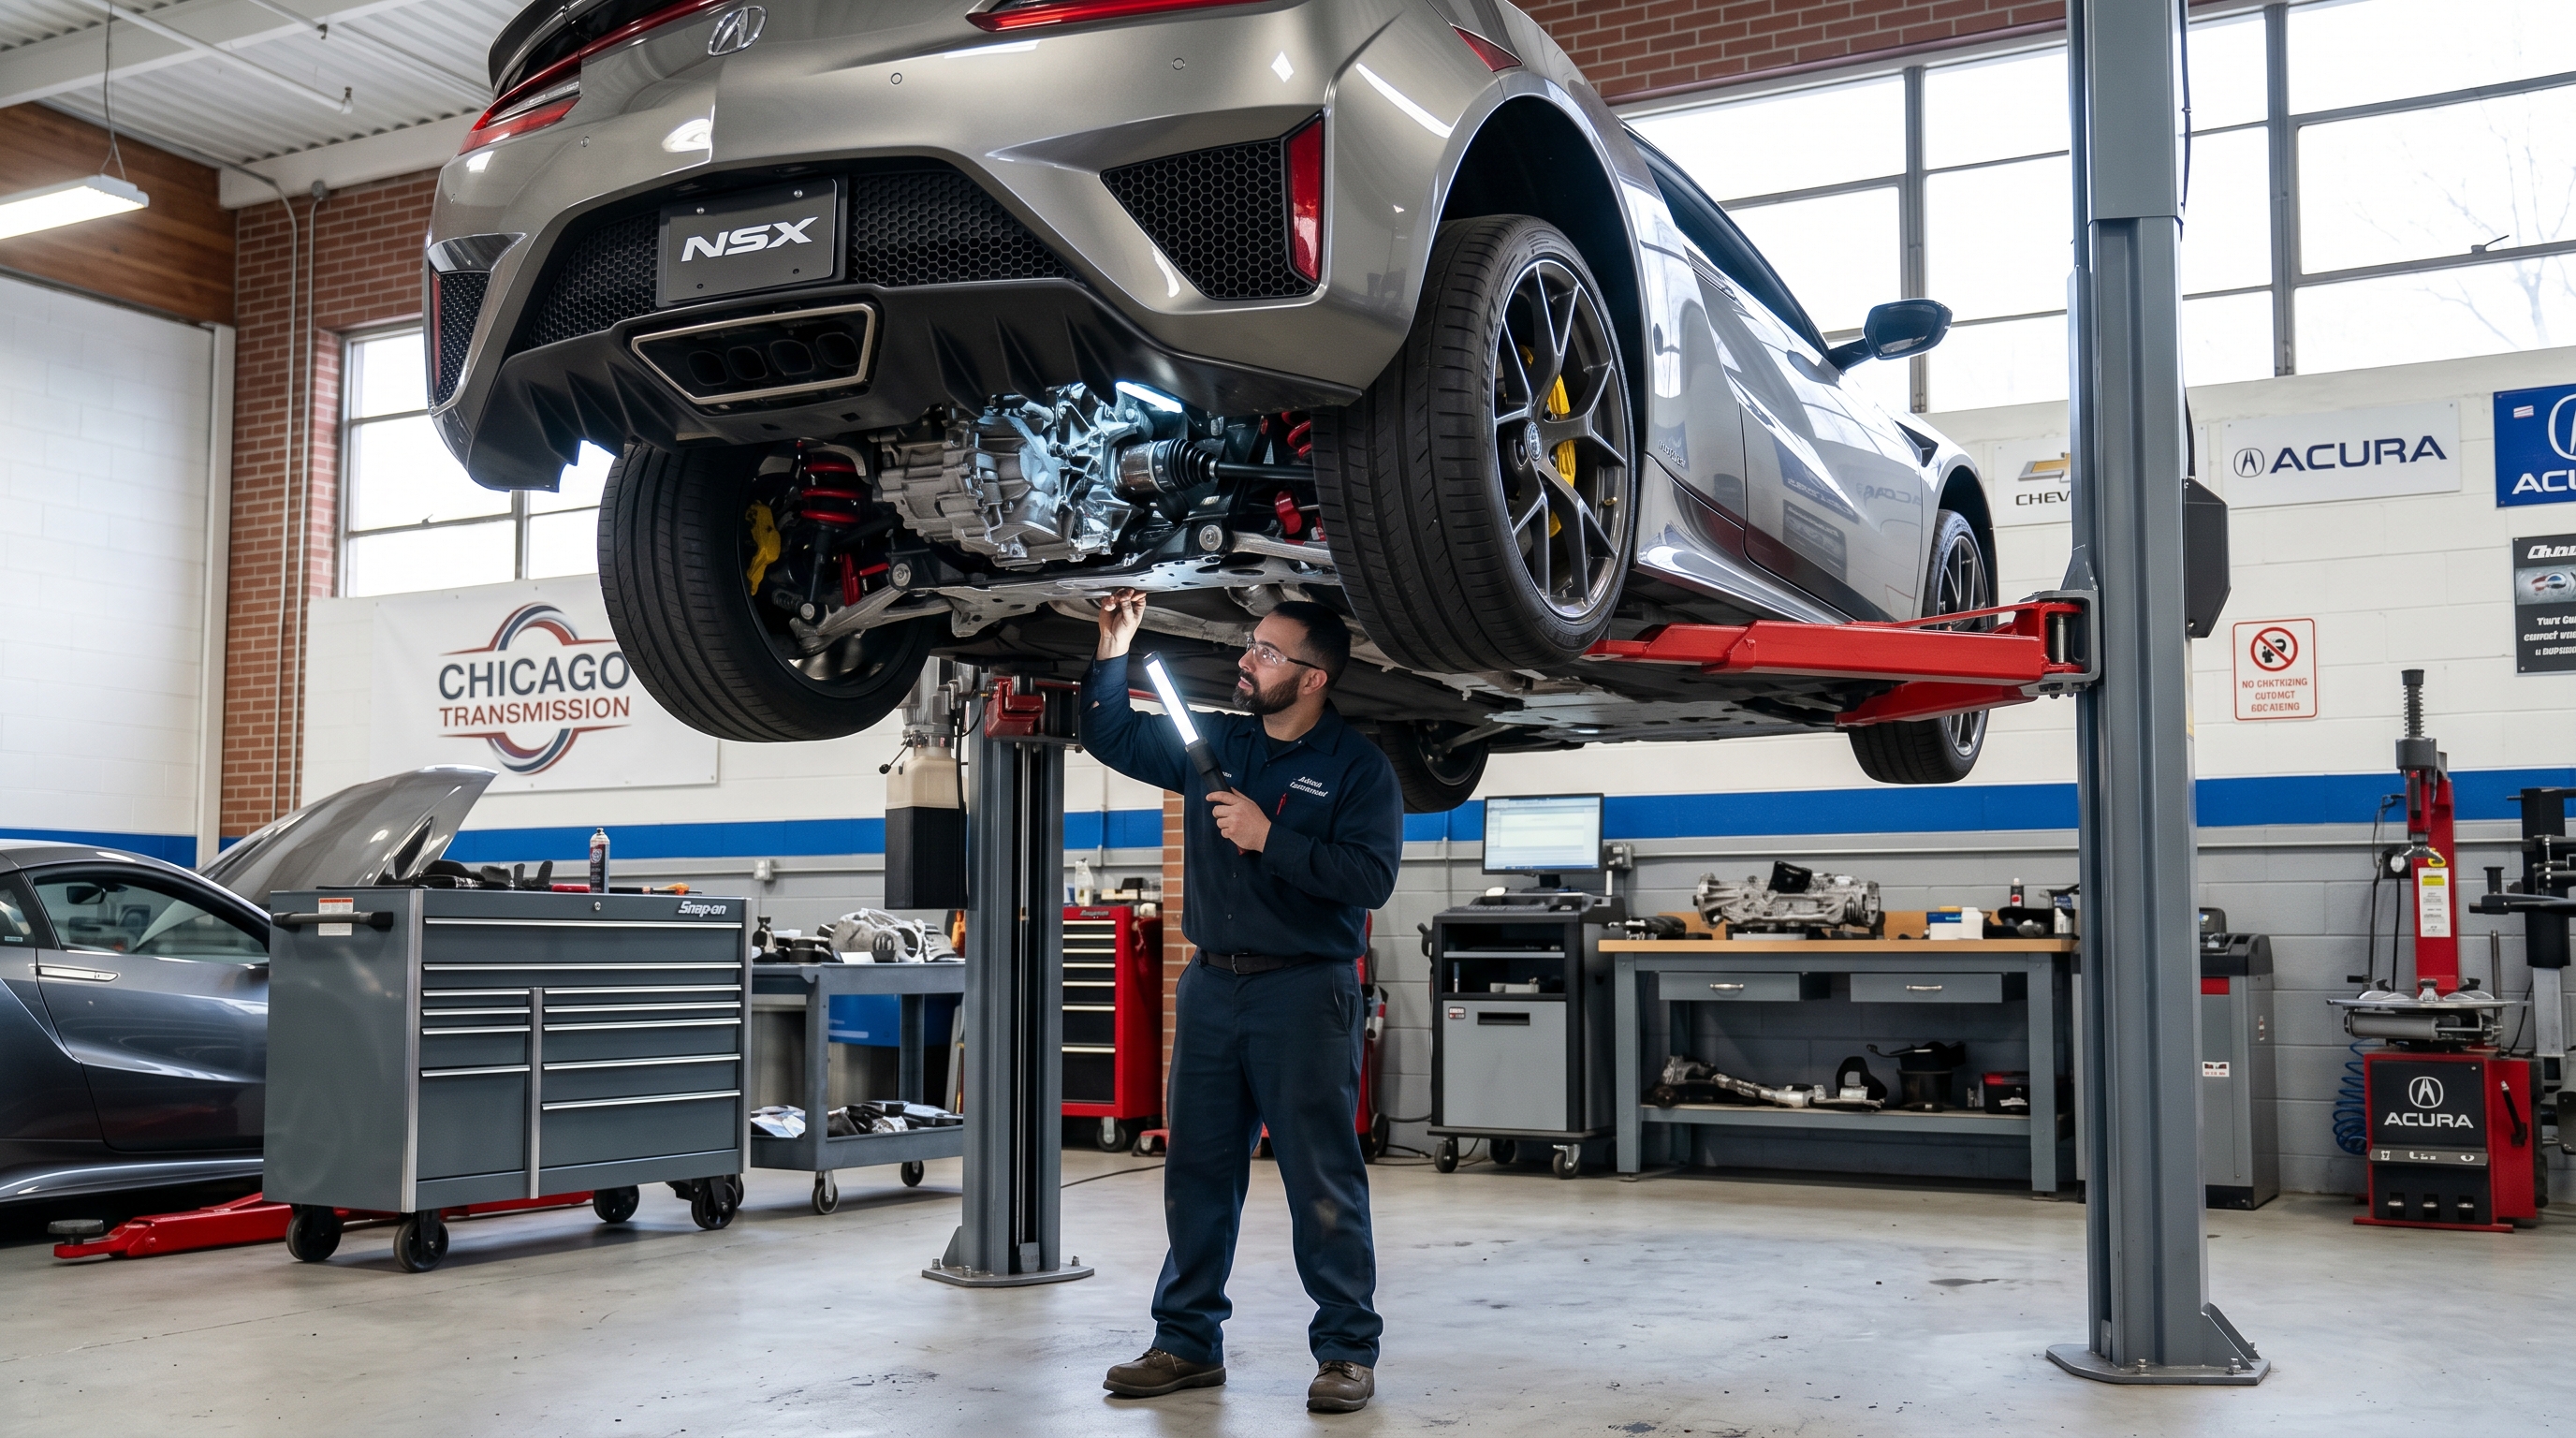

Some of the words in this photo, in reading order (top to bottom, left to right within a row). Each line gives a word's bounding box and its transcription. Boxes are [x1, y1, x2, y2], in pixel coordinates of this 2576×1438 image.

[681, 216, 819, 262] NSX
[2269, 435, 2448, 474] ACURA
[438, 651, 630, 700] CHICAGO
[2242, 680, 2255, 689] NO
[439, 696, 631, 727] TRANSMISSION
[2384, 1111, 2474, 1129] ACURA
